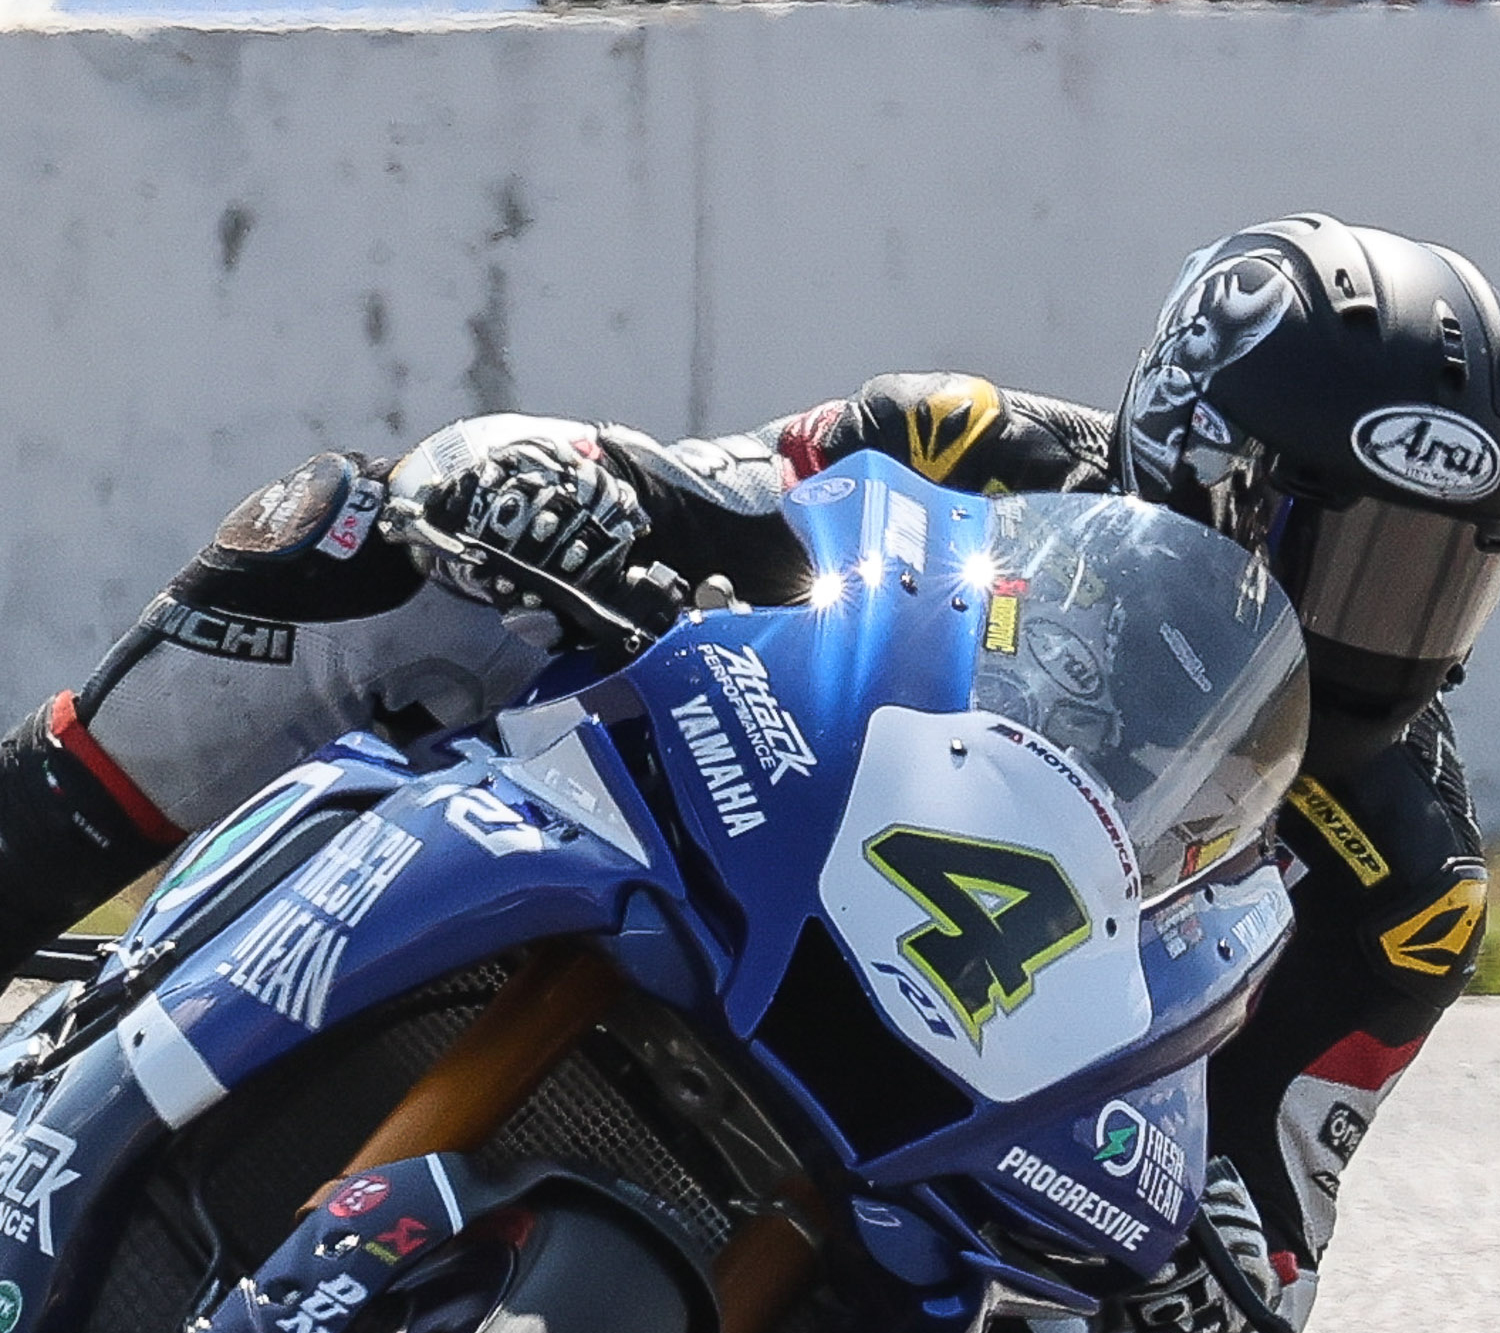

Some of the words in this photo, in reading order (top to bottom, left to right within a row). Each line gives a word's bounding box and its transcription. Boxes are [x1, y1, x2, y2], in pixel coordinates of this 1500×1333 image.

[1374, 420, 1486, 478] Arai
[698, 643, 777, 770] PERFORMANCE
[670, 694, 768, 838] YAMAHA
[862, 823, 1093, 1058] 4
[997, 1145, 1150, 1252] PROGRESSIVE
[1146, 1123, 1186, 1185] FRESH
[1147, 1164, 1185, 1226] LEAN
